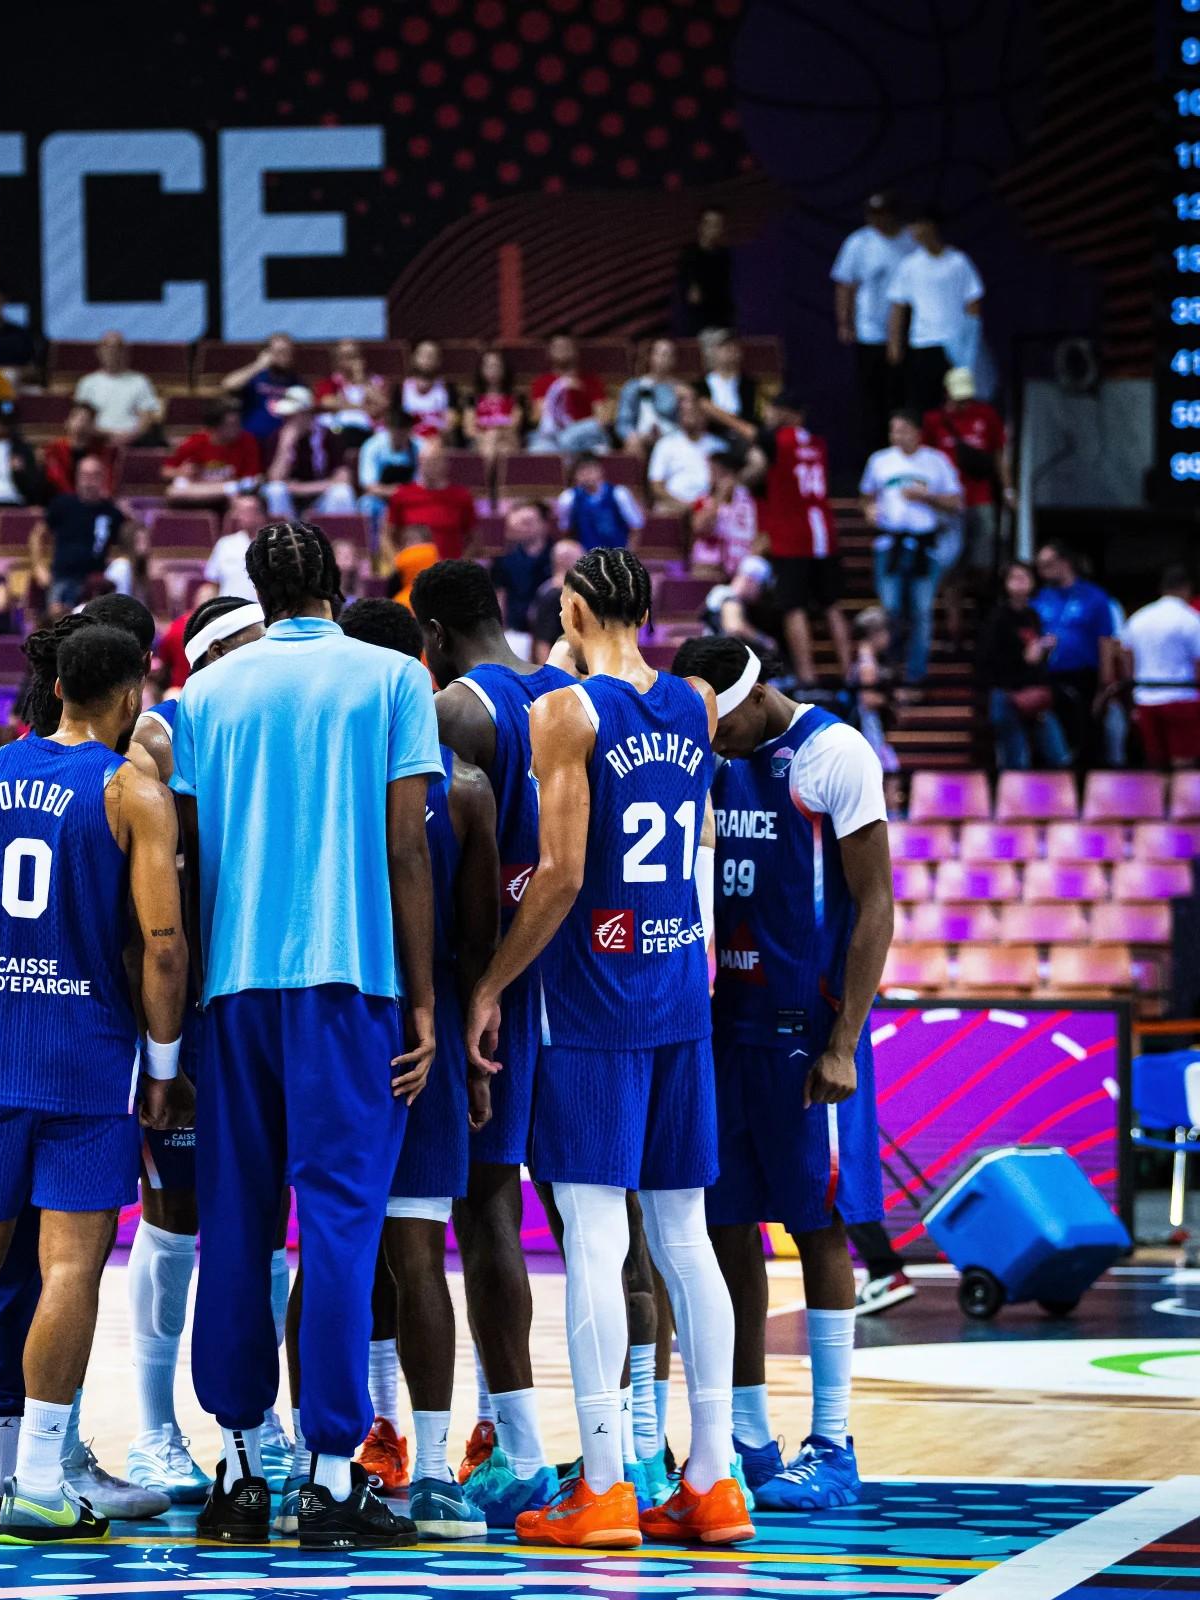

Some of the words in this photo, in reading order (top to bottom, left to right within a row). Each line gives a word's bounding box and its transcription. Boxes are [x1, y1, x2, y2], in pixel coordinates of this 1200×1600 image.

[605, 732, 704, 779] RISACHER
[622, 800, 696, 883] 21
[713, 809, 778, 840] RANCE
[1, 837, 52, 919] 0
[722, 858, 756, 897] 99
[720, 949, 760, 970] MAIF
